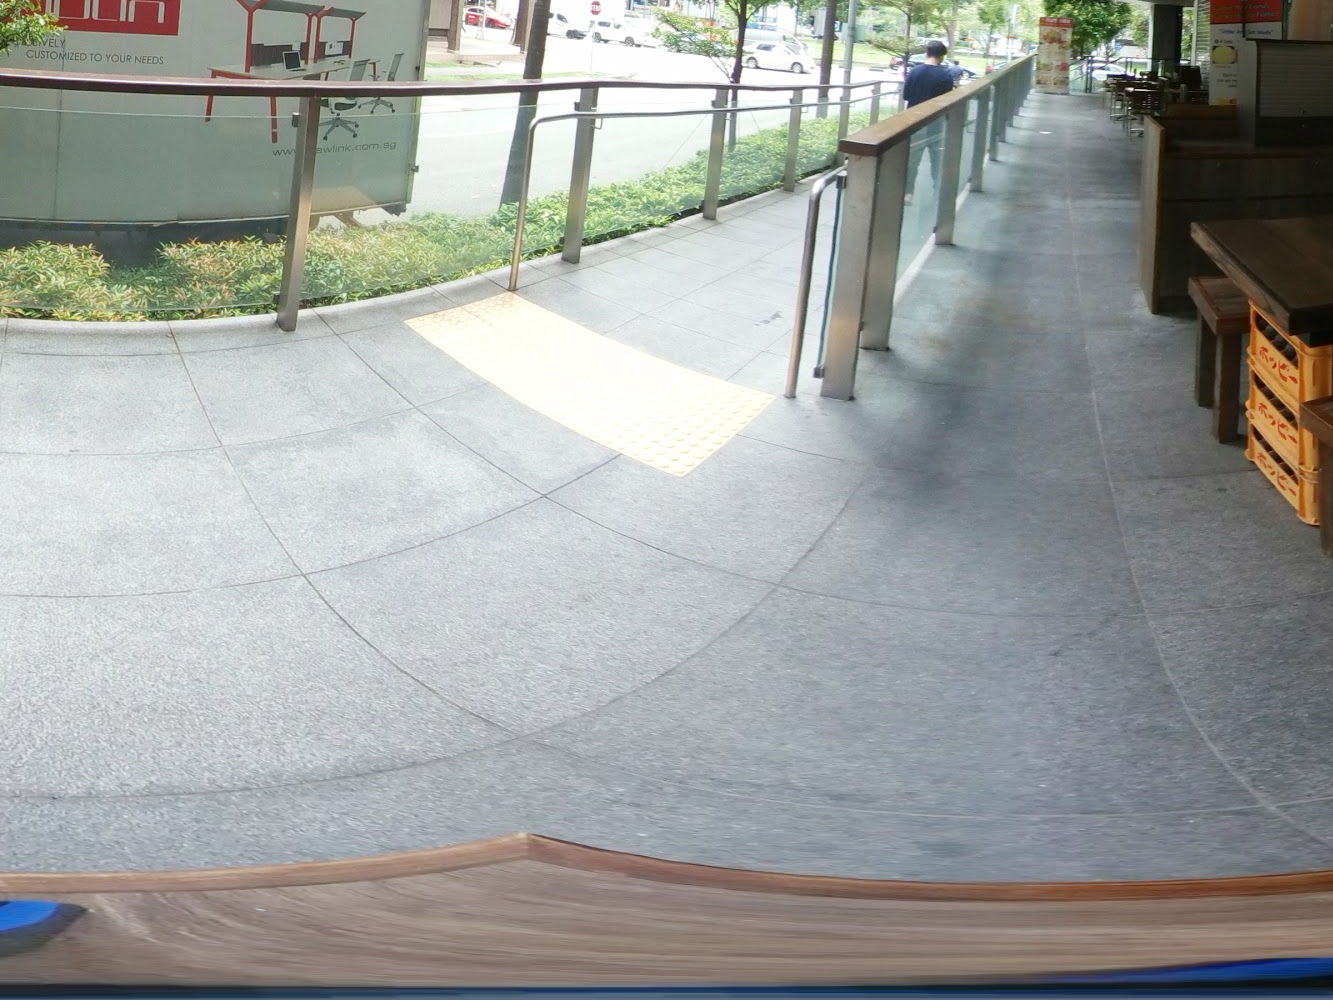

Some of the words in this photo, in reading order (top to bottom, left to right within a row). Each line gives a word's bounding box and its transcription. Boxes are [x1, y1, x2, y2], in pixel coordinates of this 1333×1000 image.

[26, 50, 87, 62] CUSTOMIZED
[90, 53, 102, 62] TO
[106, 53, 131, 63] YOUR
[134, 55, 164, 65] NEEDS
[1259, 346, 1298, 384] ホッピー
[1258, 402, 1297, 444] ホッピー
[1256, 452, 1296, 497] ホッピー
